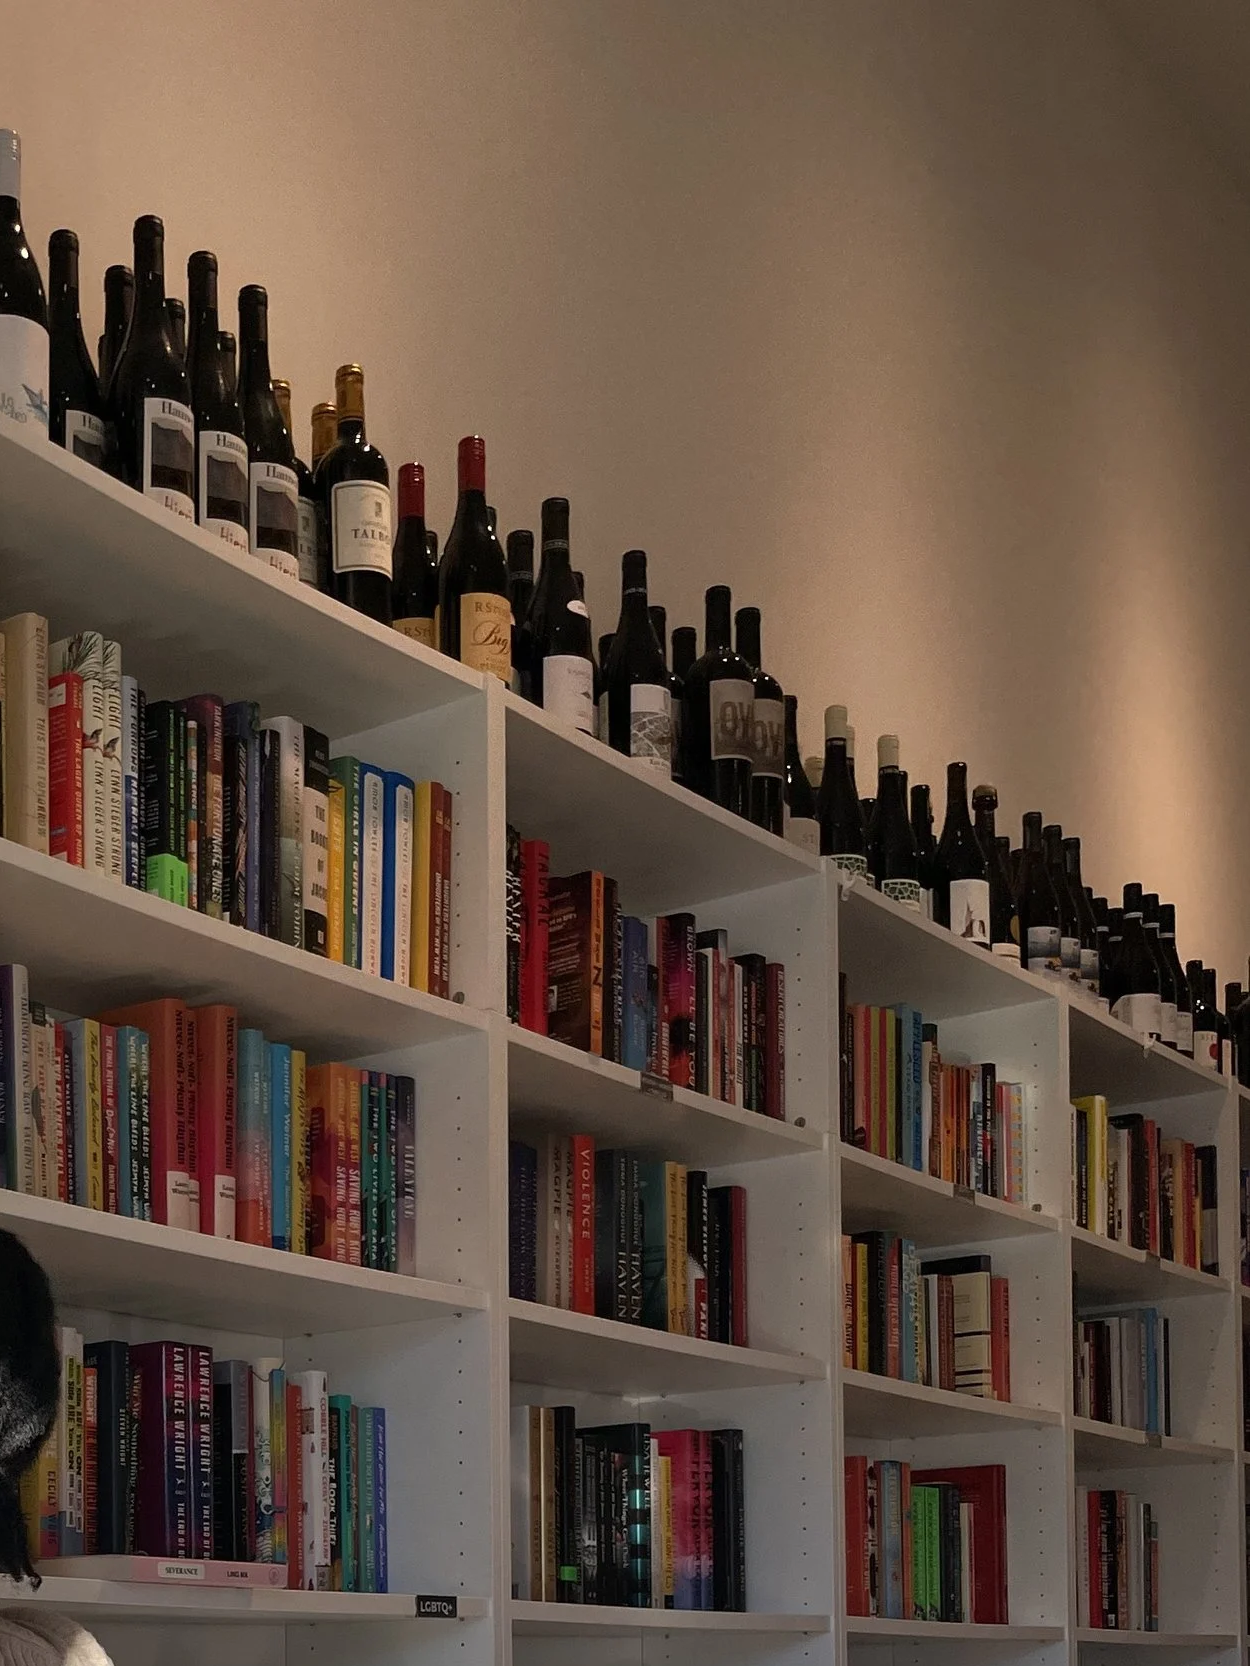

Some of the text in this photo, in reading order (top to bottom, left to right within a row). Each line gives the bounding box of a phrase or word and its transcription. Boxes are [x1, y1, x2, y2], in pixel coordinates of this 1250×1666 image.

[580, 1149, 591, 1239] VIOLENCE
[173, 1347, 185, 1471] LAWRENCE WRIGHT
[329, 1483, 337, 1514] BOOK
[421, 1601, 453, 1615] LGBTQ+
